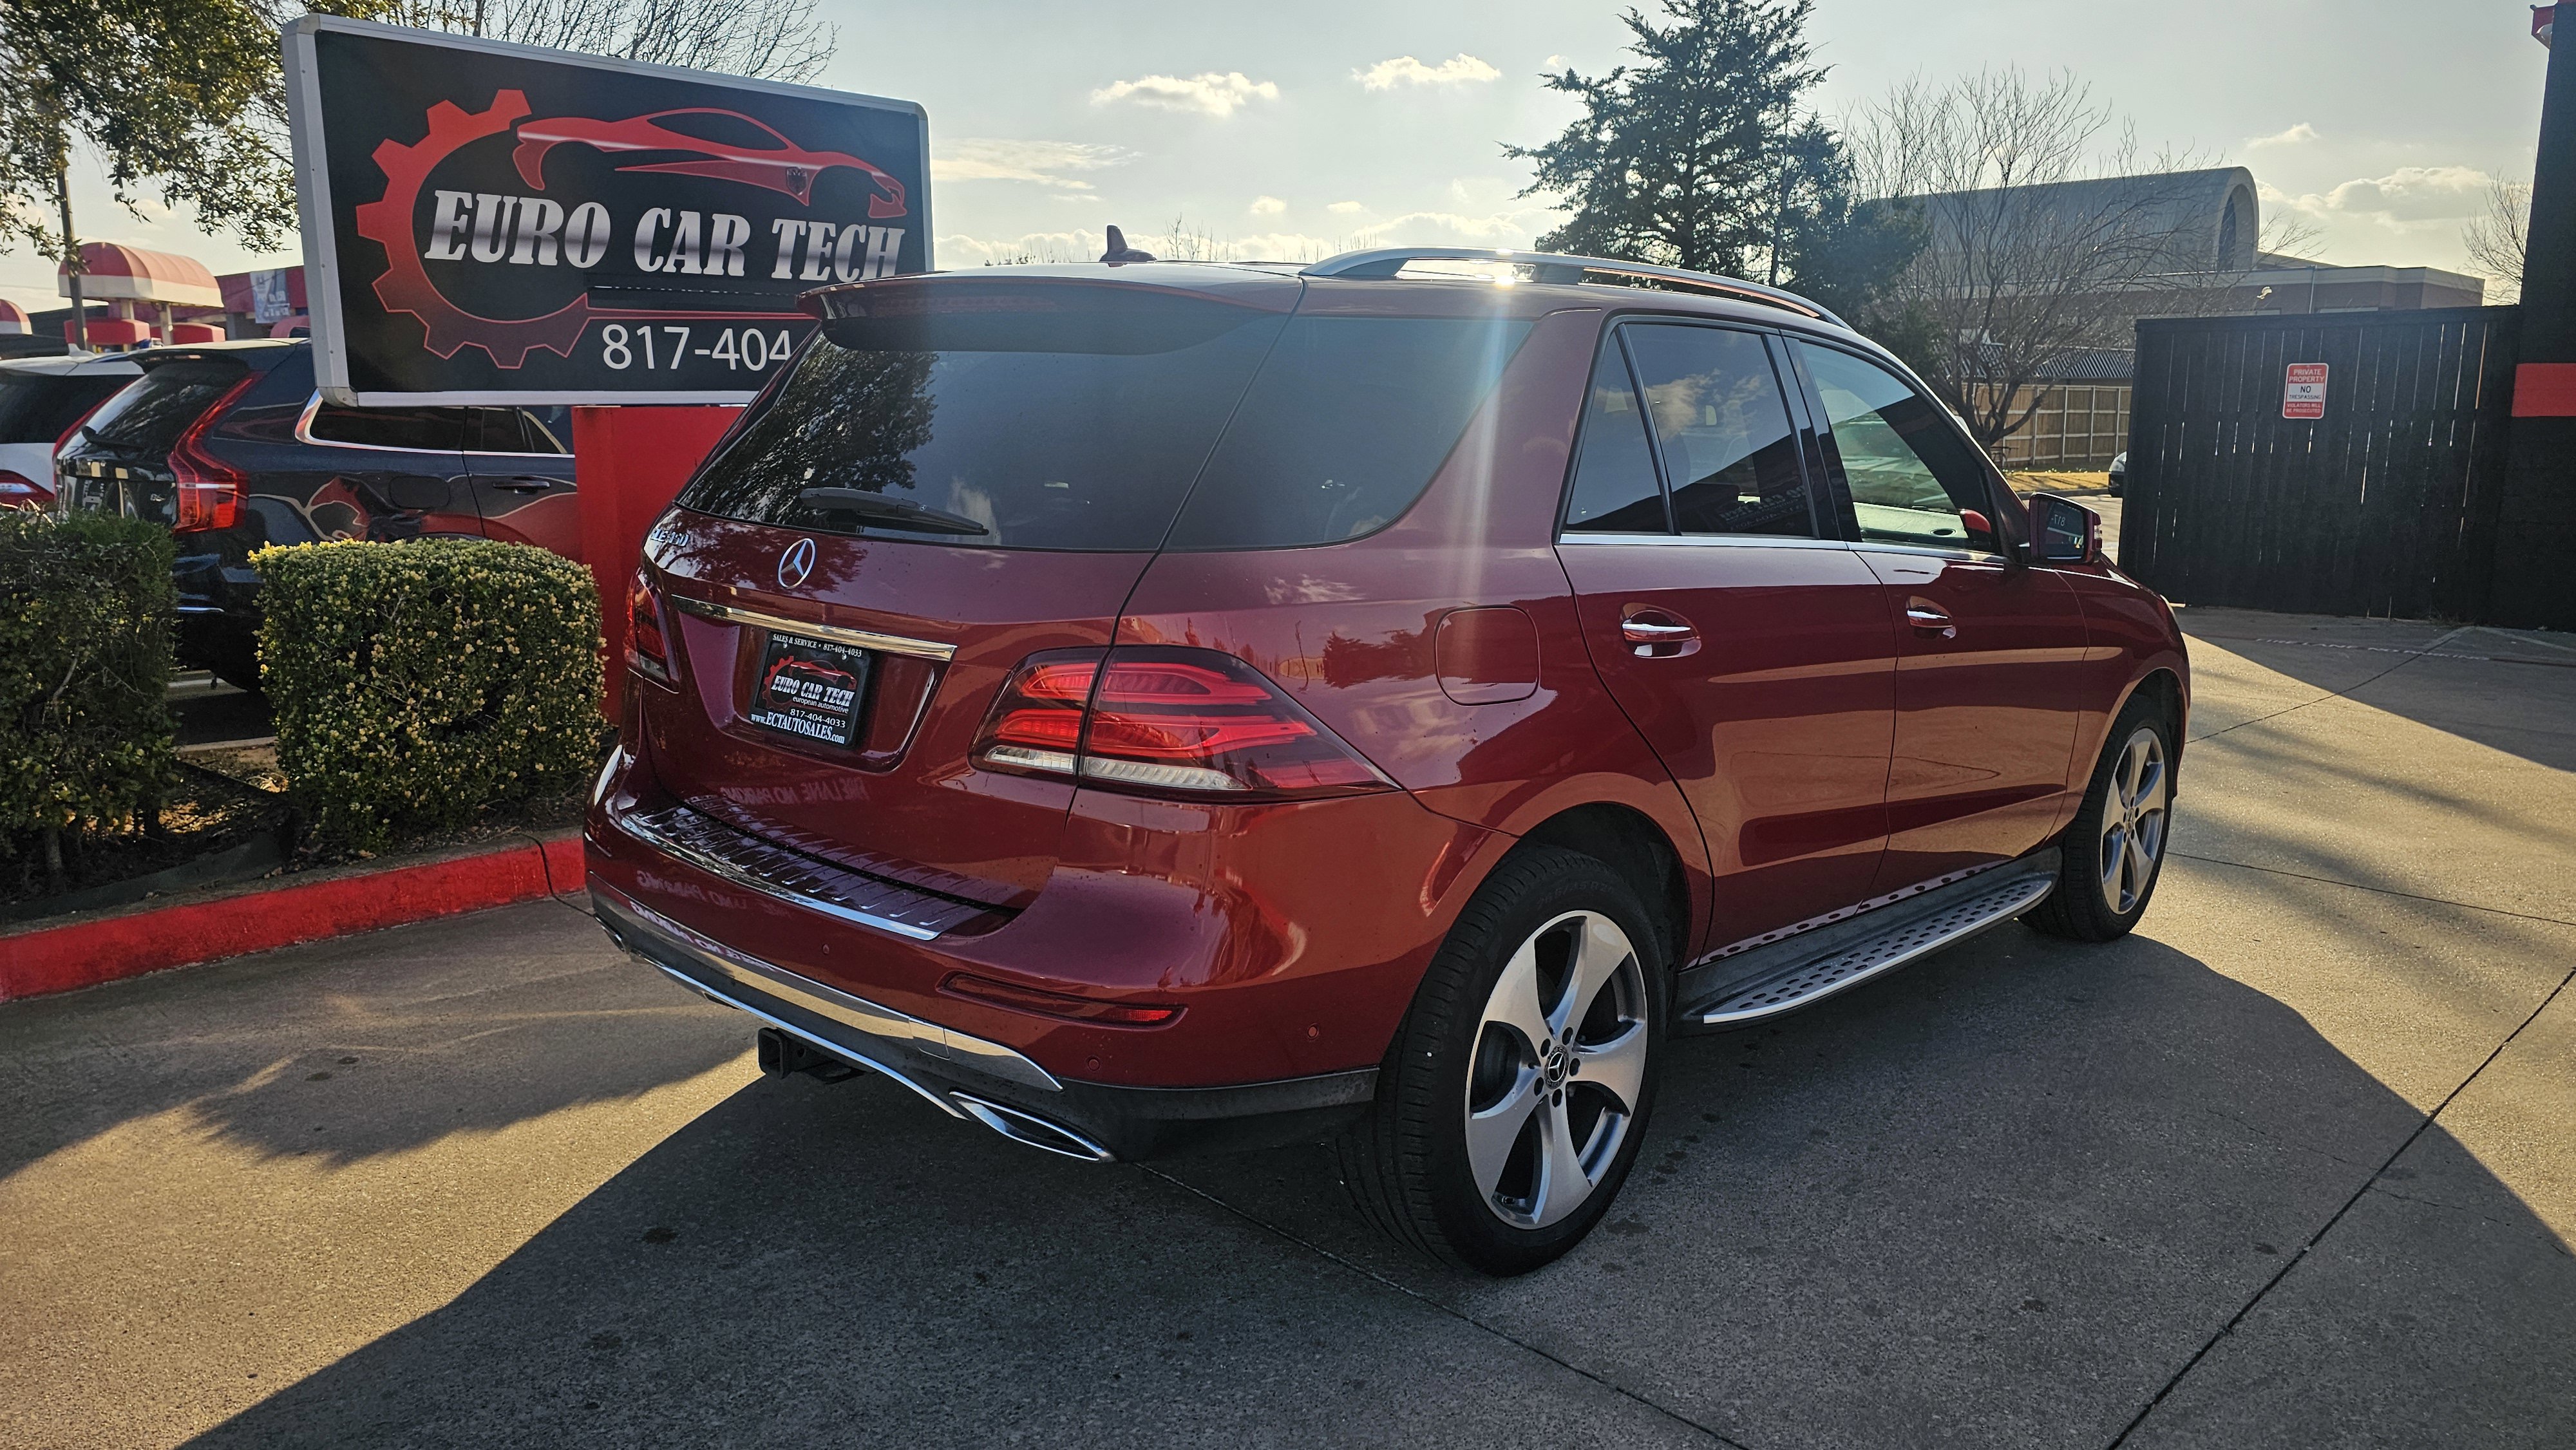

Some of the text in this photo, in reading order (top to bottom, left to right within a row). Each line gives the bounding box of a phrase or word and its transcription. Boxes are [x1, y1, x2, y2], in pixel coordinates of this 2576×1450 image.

[424, 190, 905, 282] EURO CAR TECH
[602, 324, 791, 372] 817-404
[773, 634, 788, 643] SALES
[794, 637, 817, 648] SERVICE
[822, 643, 862, 657] 817-404-4033
[772, 675, 855, 707] EURO CAR TECH
[793, 696, 849, 714] european automotive
[751, 711, 846, 744] www.ECTAUTOSALES.com
[790, 709, 846, 728] 817-404-4033
